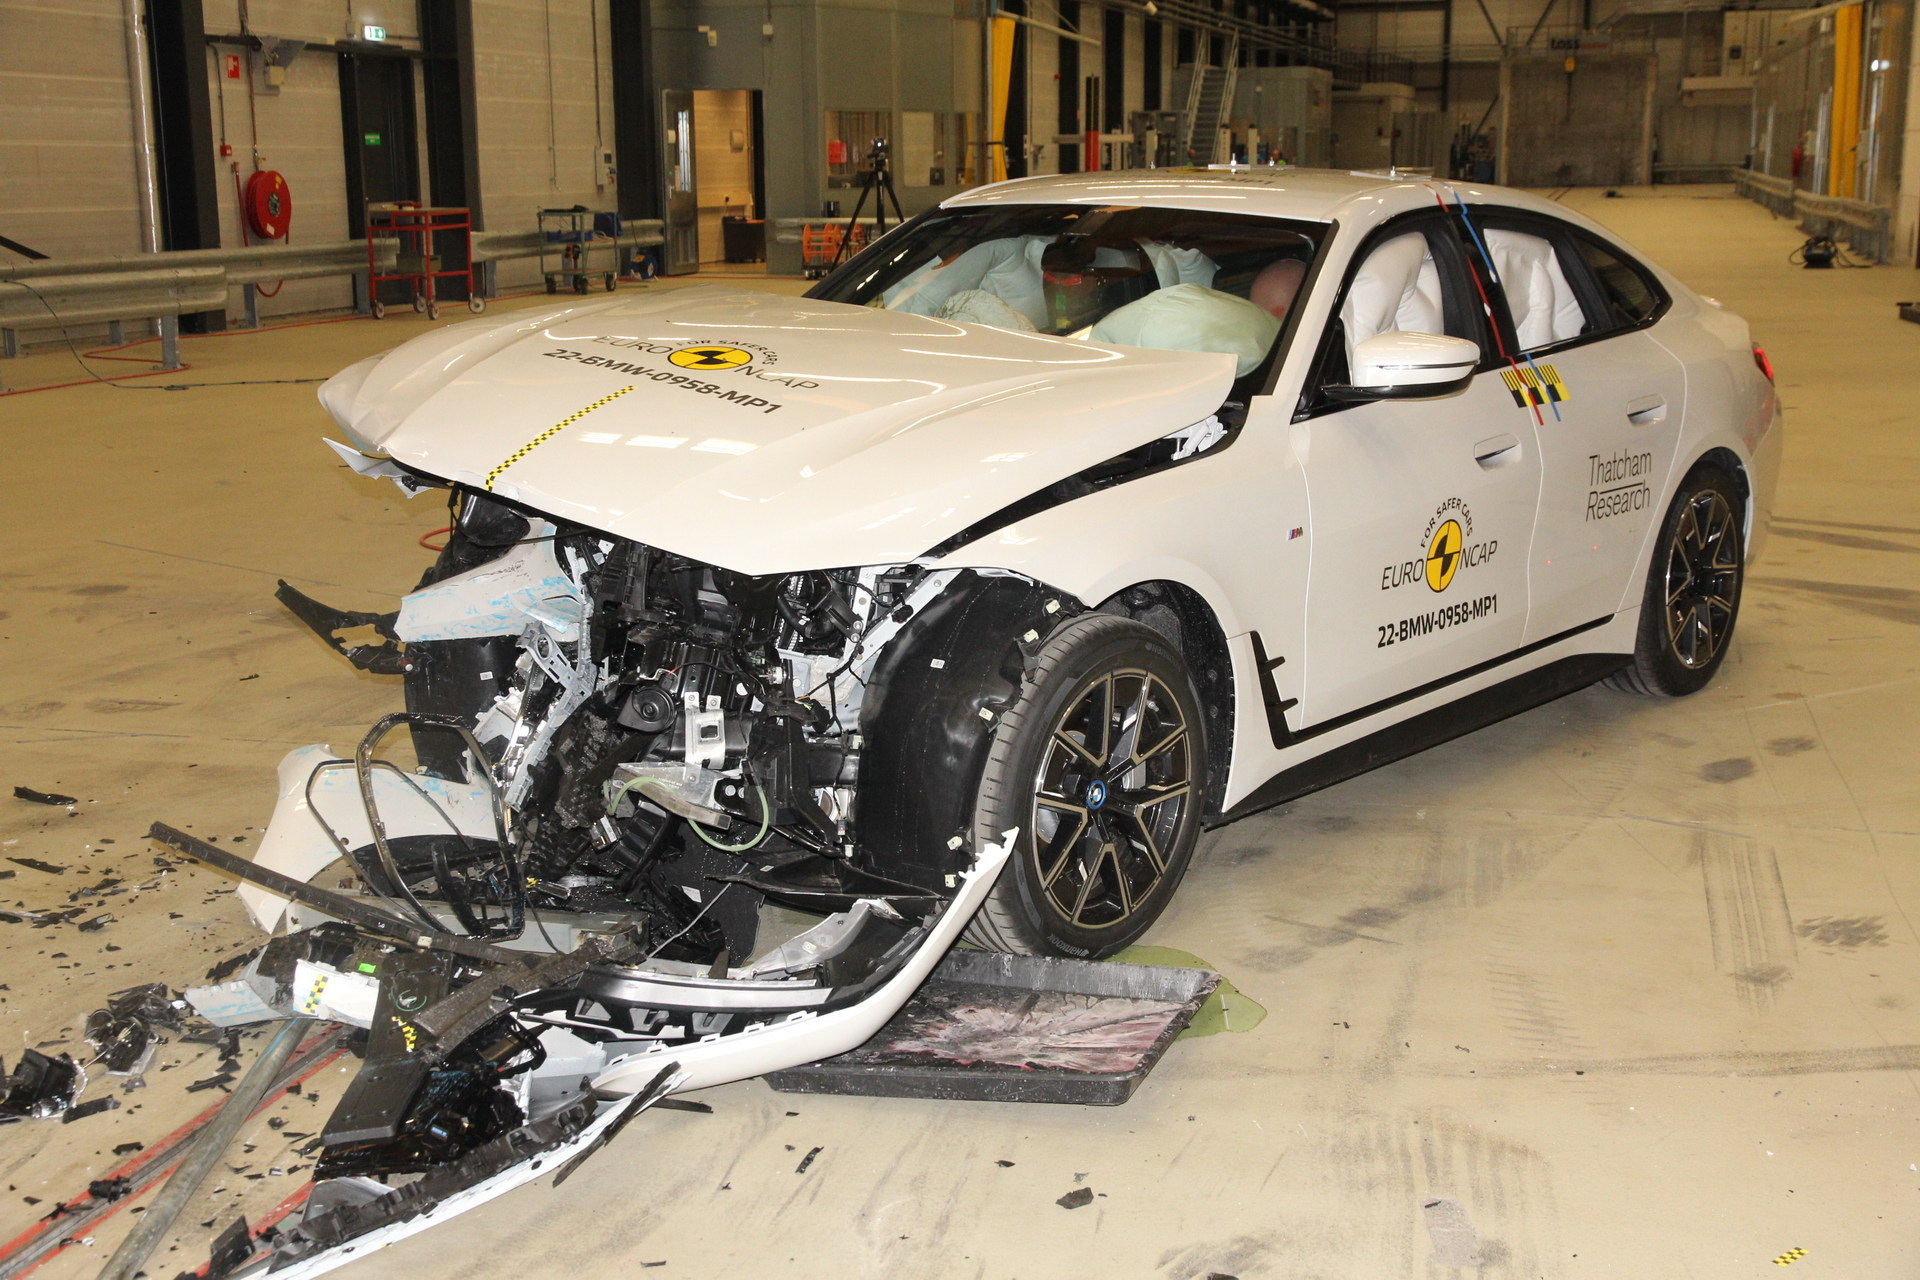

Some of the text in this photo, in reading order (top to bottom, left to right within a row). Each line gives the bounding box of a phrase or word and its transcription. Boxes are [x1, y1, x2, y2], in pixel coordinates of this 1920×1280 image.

[592, 336, 819, 389] EURO NCAP
[718, 340, 768, 351] SAFER
[762, 351, 778, 365] CARS
[542, 348, 783, 414] 22-BMW-0958-MP1
[1589, 448, 1652, 486] Thatcham
[1420, 497, 1474, 548] FOR SAFER CARS
[1585, 479, 1651, 522] Research
[1381, 540, 1498, 590] EURO NCAP
[1377, 593, 1498, 648] 22-BMW-0958-MP1
